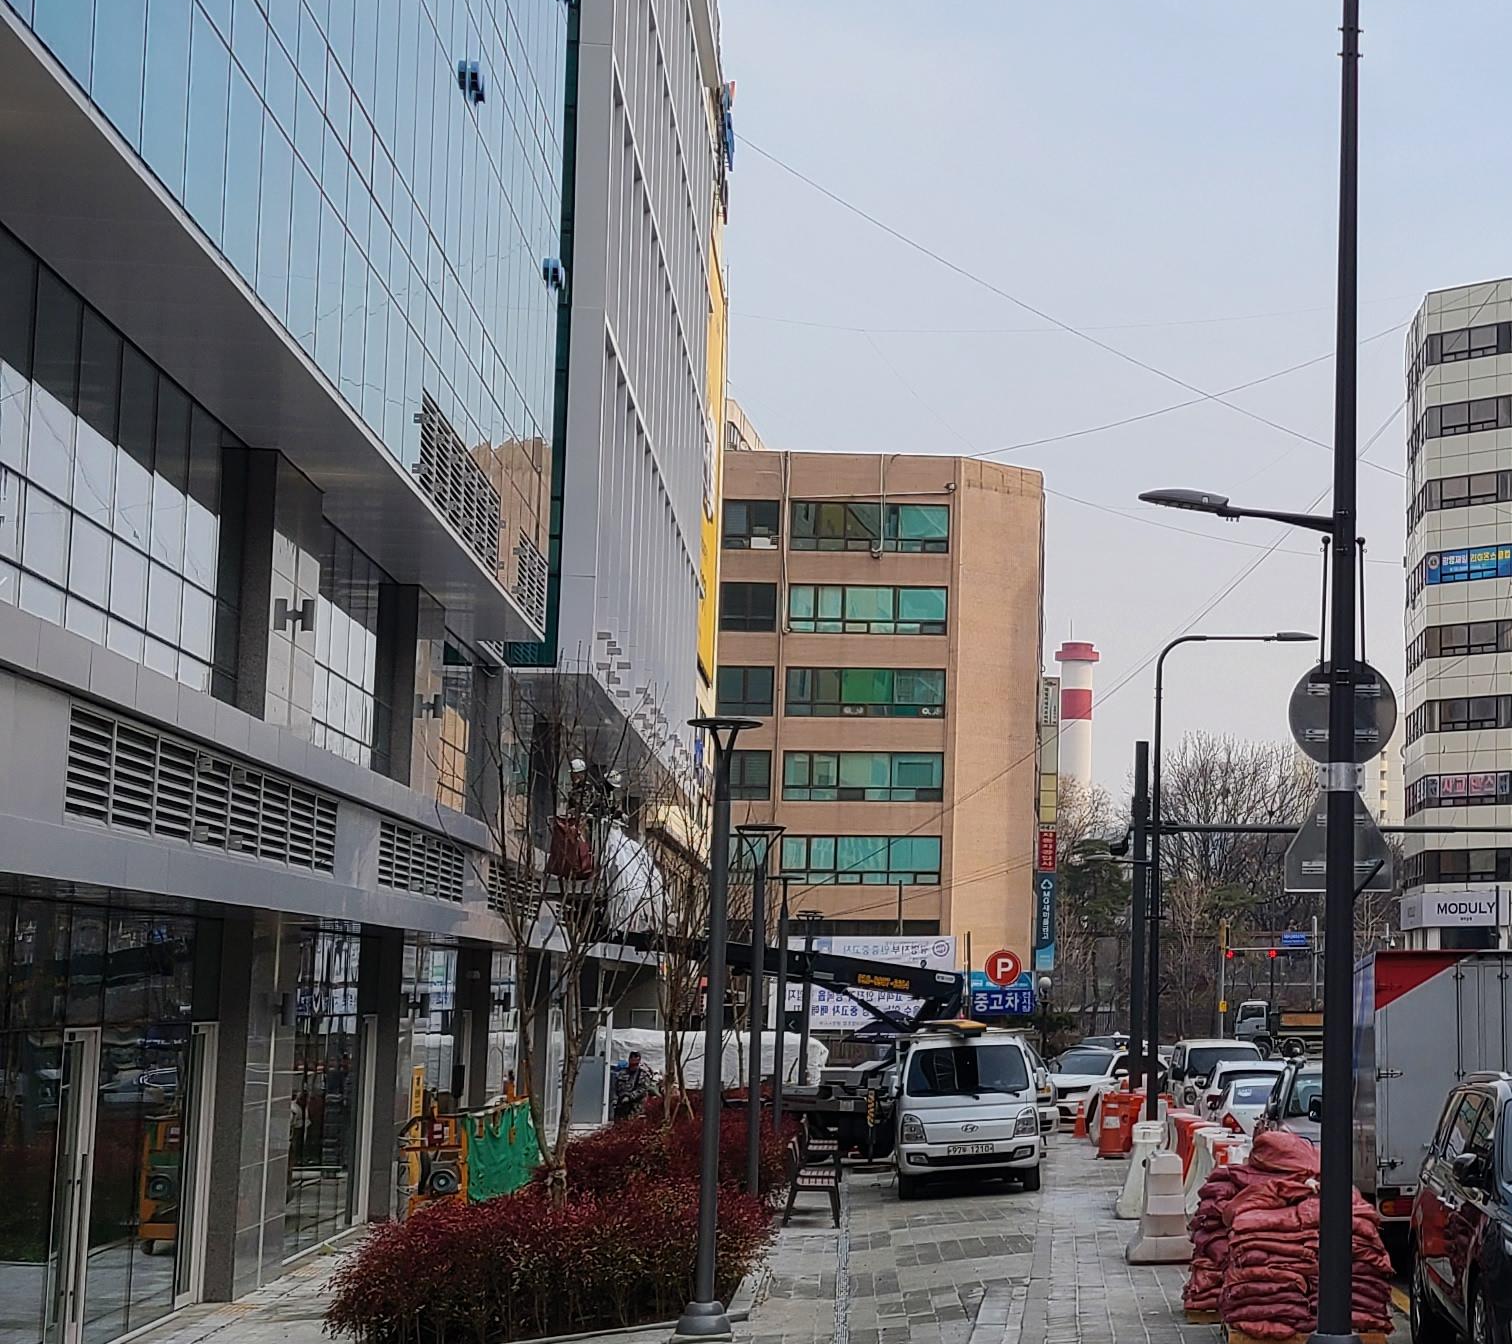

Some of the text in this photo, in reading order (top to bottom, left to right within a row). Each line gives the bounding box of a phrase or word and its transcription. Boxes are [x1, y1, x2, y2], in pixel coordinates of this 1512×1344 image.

[1436, 901, 1496, 915] MODULY
[996, 958, 1014, 980] P
[974, 992, 1020, 1012] 중고차
